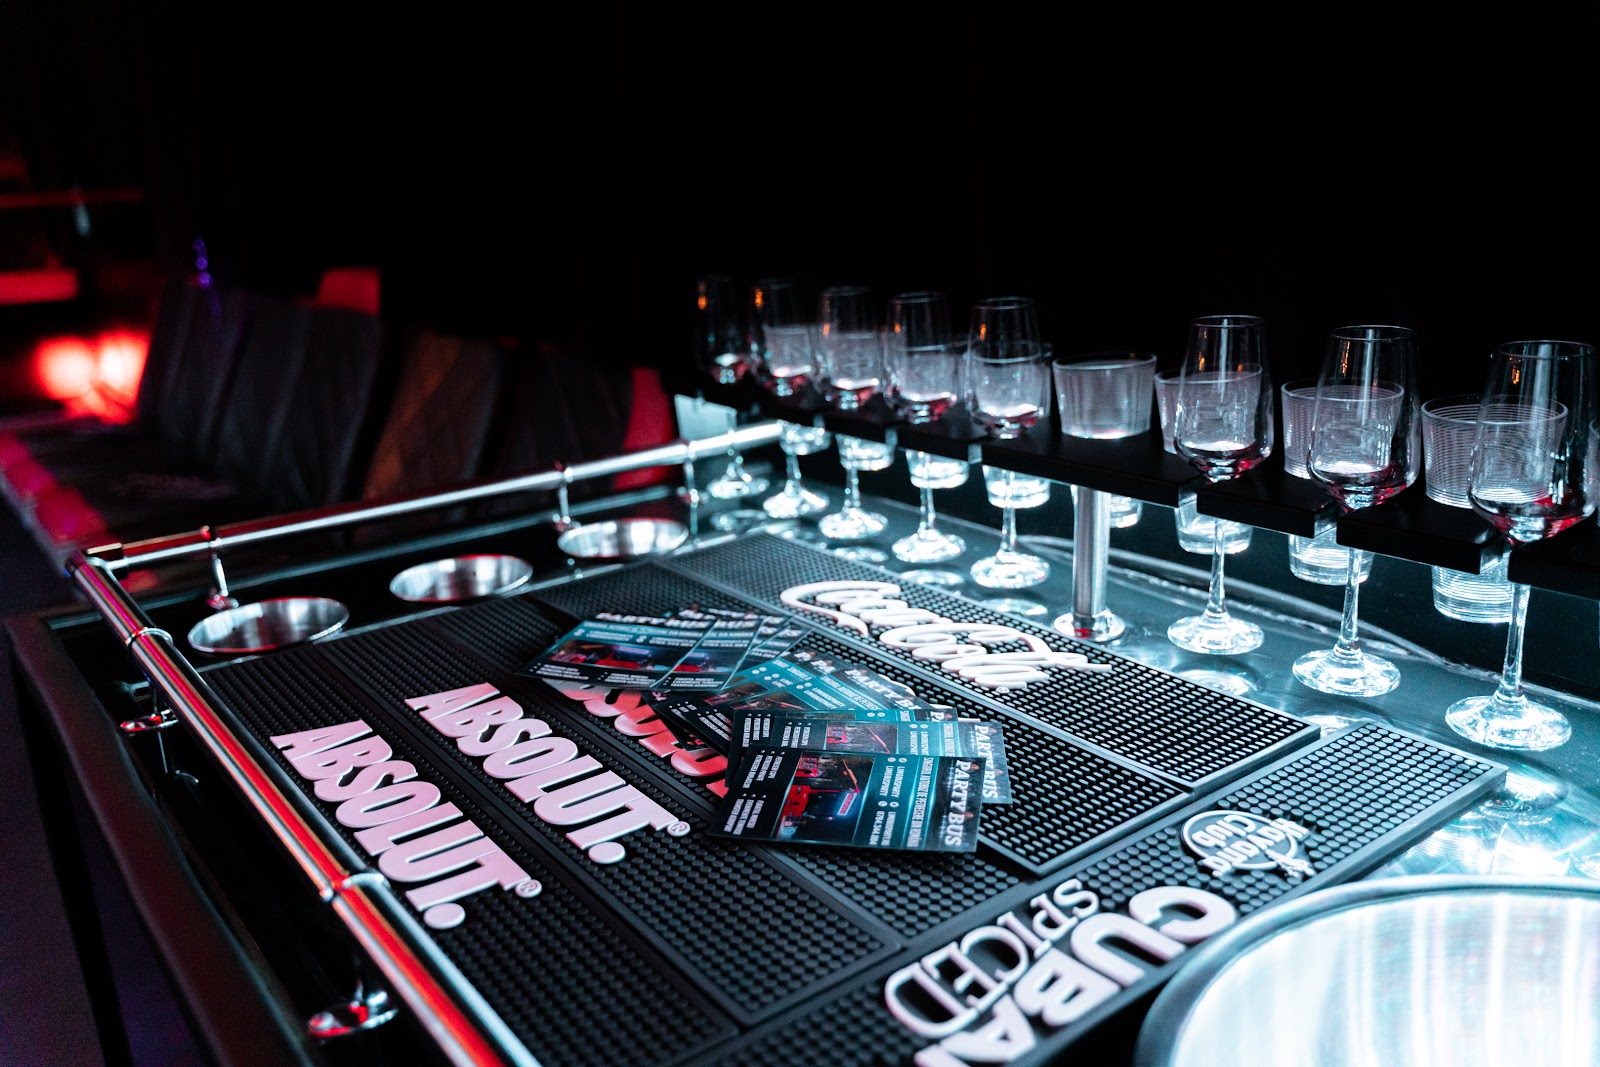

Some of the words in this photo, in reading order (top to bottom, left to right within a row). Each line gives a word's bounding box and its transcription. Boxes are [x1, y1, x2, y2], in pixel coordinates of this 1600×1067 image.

[845, 669, 899, 699] PARTY
[950, 759, 972, 812] PARTY
[944, 812, 966, 847] BUS
[1191, 814, 1257, 847] Club
[1202, 818, 1311, 878] Havana
[884, 878, 1100, 1038] SPICED
[914, 885, 1236, 1067] CUBA
